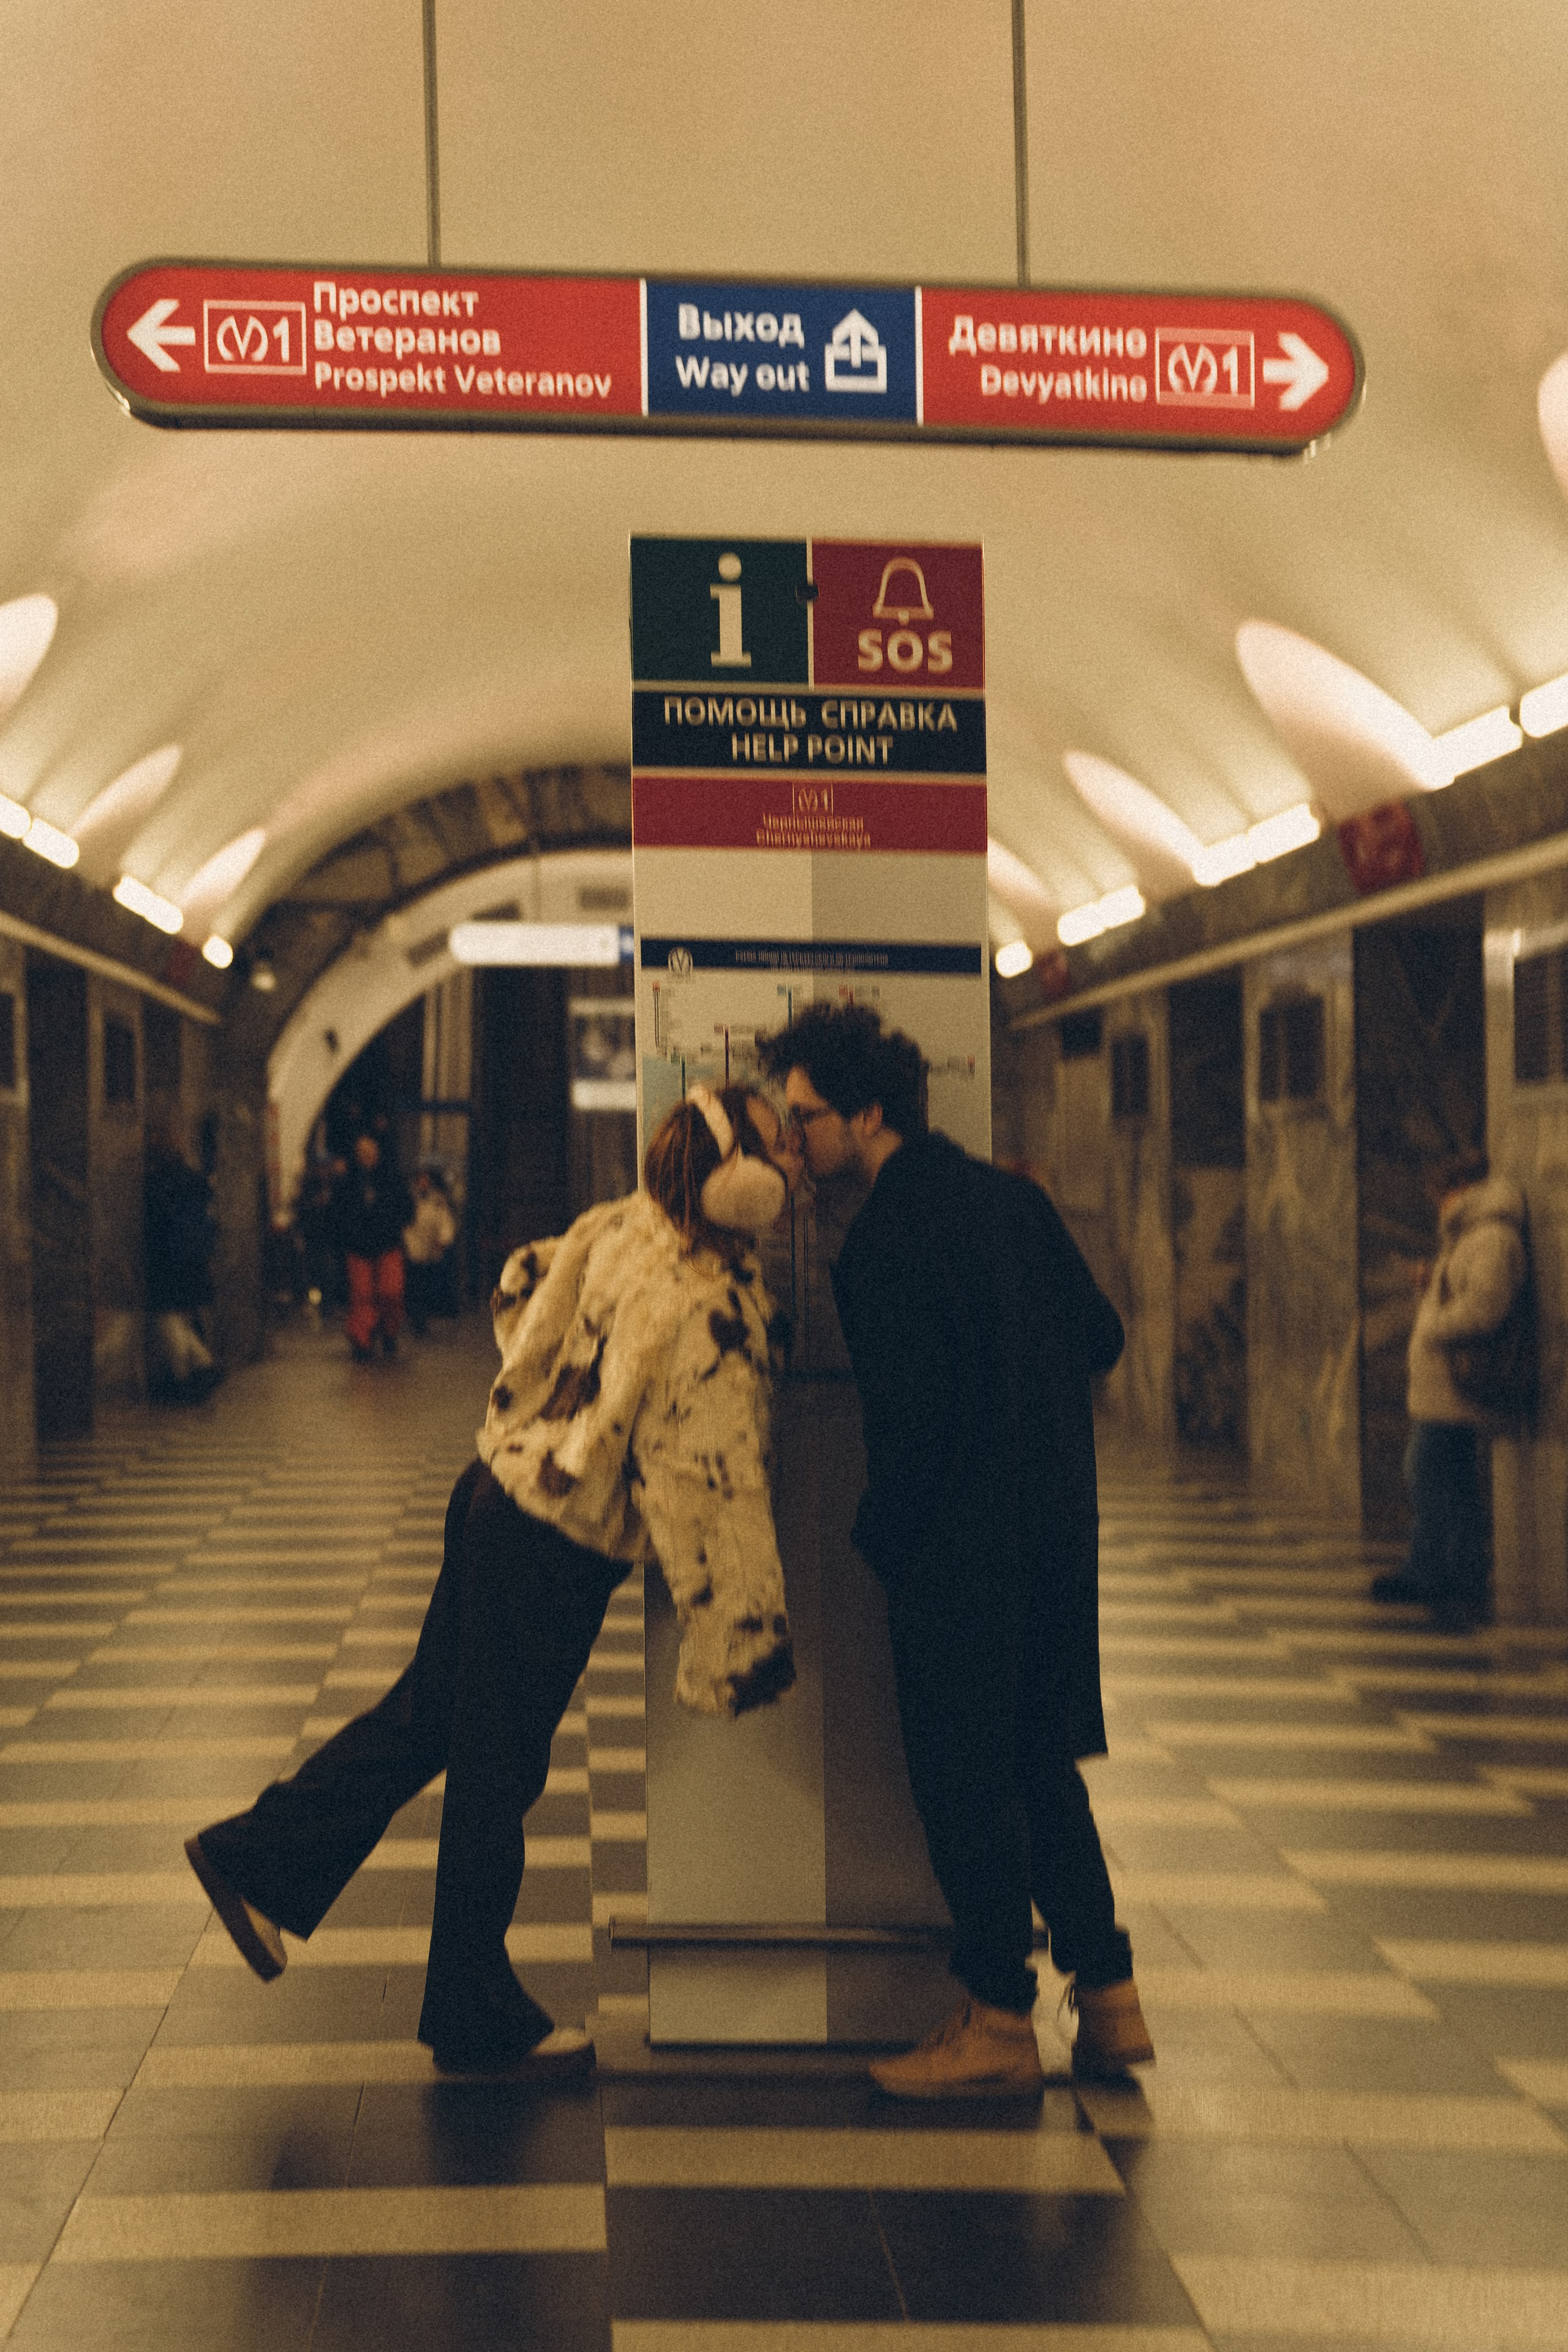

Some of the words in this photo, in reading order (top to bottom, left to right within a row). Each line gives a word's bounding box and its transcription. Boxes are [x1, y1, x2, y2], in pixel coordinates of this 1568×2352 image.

[314, 281, 479, 320] Проспект
[314, 320, 501, 360] Ветеранов
[678, 304, 805, 349] Выход
[949, 315, 1148, 359] Девяткино
[315, 361, 446, 398] Prospekt
[454, 366, 612, 398] Veteranov
[676, 355, 748, 396] Way
[755, 361, 810, 392] out
[981, 364, 1148, 404] Devyatkino
[858, 628, 953, 673] SOS
[664, 696, 806, 731] ПОМОЩЬ
[821, 700, 958, 733] СПРАВКА
[732, 733, 799, 763] HELP
[807, 734, 894, 764] POINT
